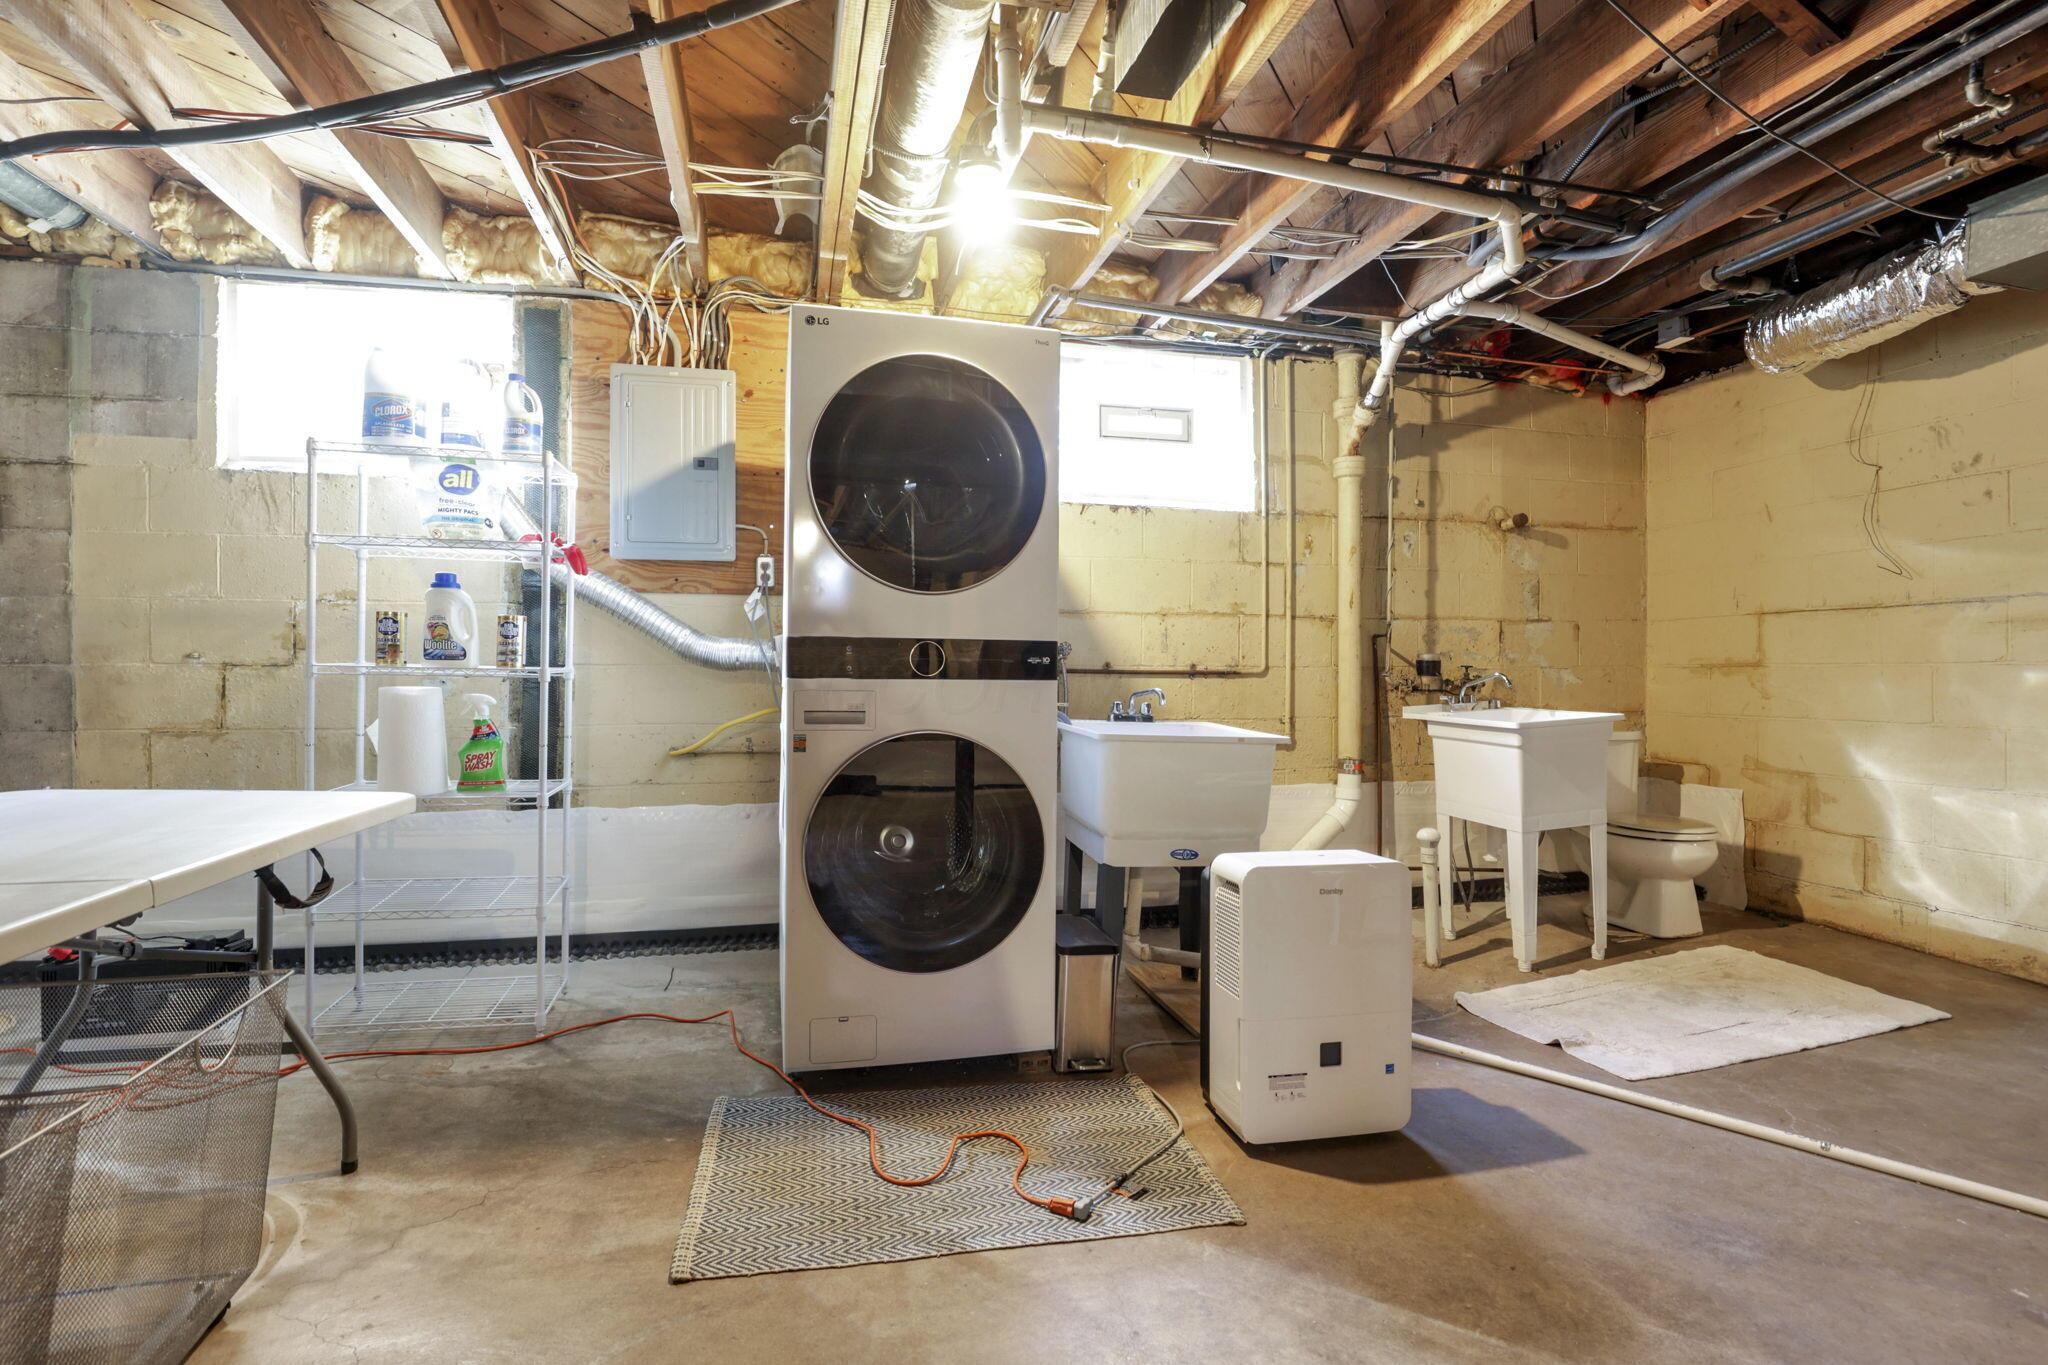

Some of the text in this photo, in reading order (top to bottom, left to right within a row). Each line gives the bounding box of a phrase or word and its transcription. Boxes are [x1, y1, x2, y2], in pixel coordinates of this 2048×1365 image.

[817, 317, 829, 325] LG
[374, 404, 408, 416] CLOROX
[443, 470, 473, 489] all
[424, 639, 457, 650] Woolite
[465, 750, 496, 764] SPRAY
[464, 760, 494, 772] WASH
[1319, 888, 1343, 896] Danby
